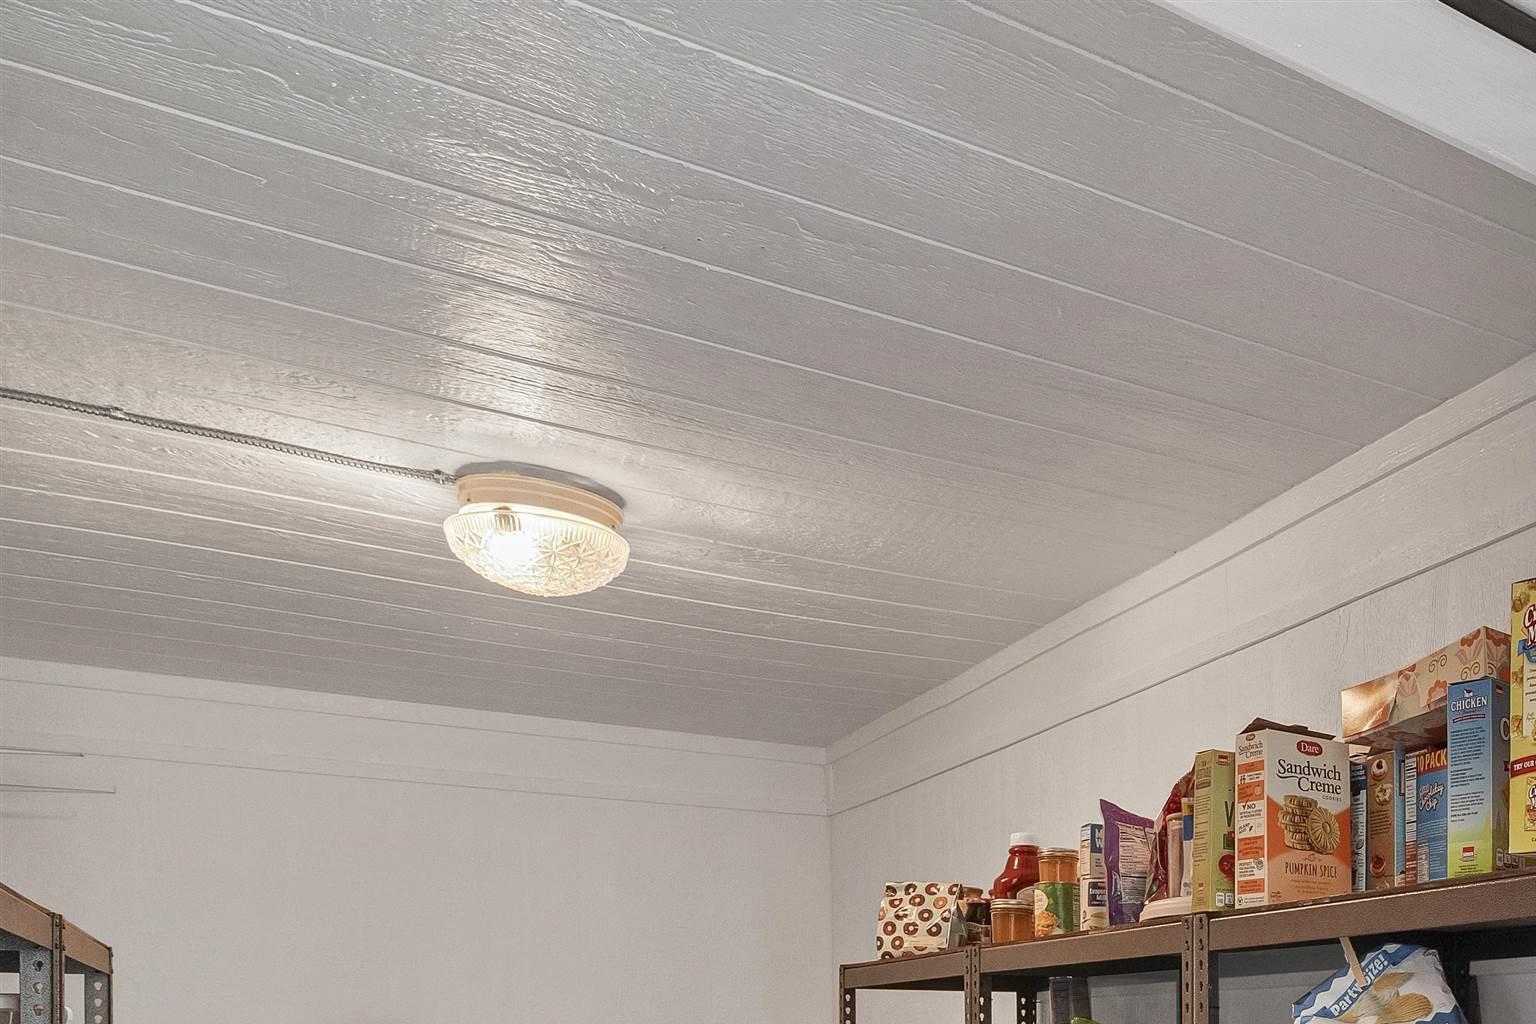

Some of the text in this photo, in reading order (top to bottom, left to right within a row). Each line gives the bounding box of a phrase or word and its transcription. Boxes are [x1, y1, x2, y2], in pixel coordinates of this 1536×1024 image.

[1450, 695, 1488, 712] CHICKEN
[1301, 743, 1320, 754] Dare
[1425, 749, 1447, 768] PACK
[1277, 759, 1341, 782] Sandwich
[1297, 777, 1342, 795] Creme
[1285, 861, 1318, 876] PUMPKIN
[1330, 983, 1363, 1017] Party
